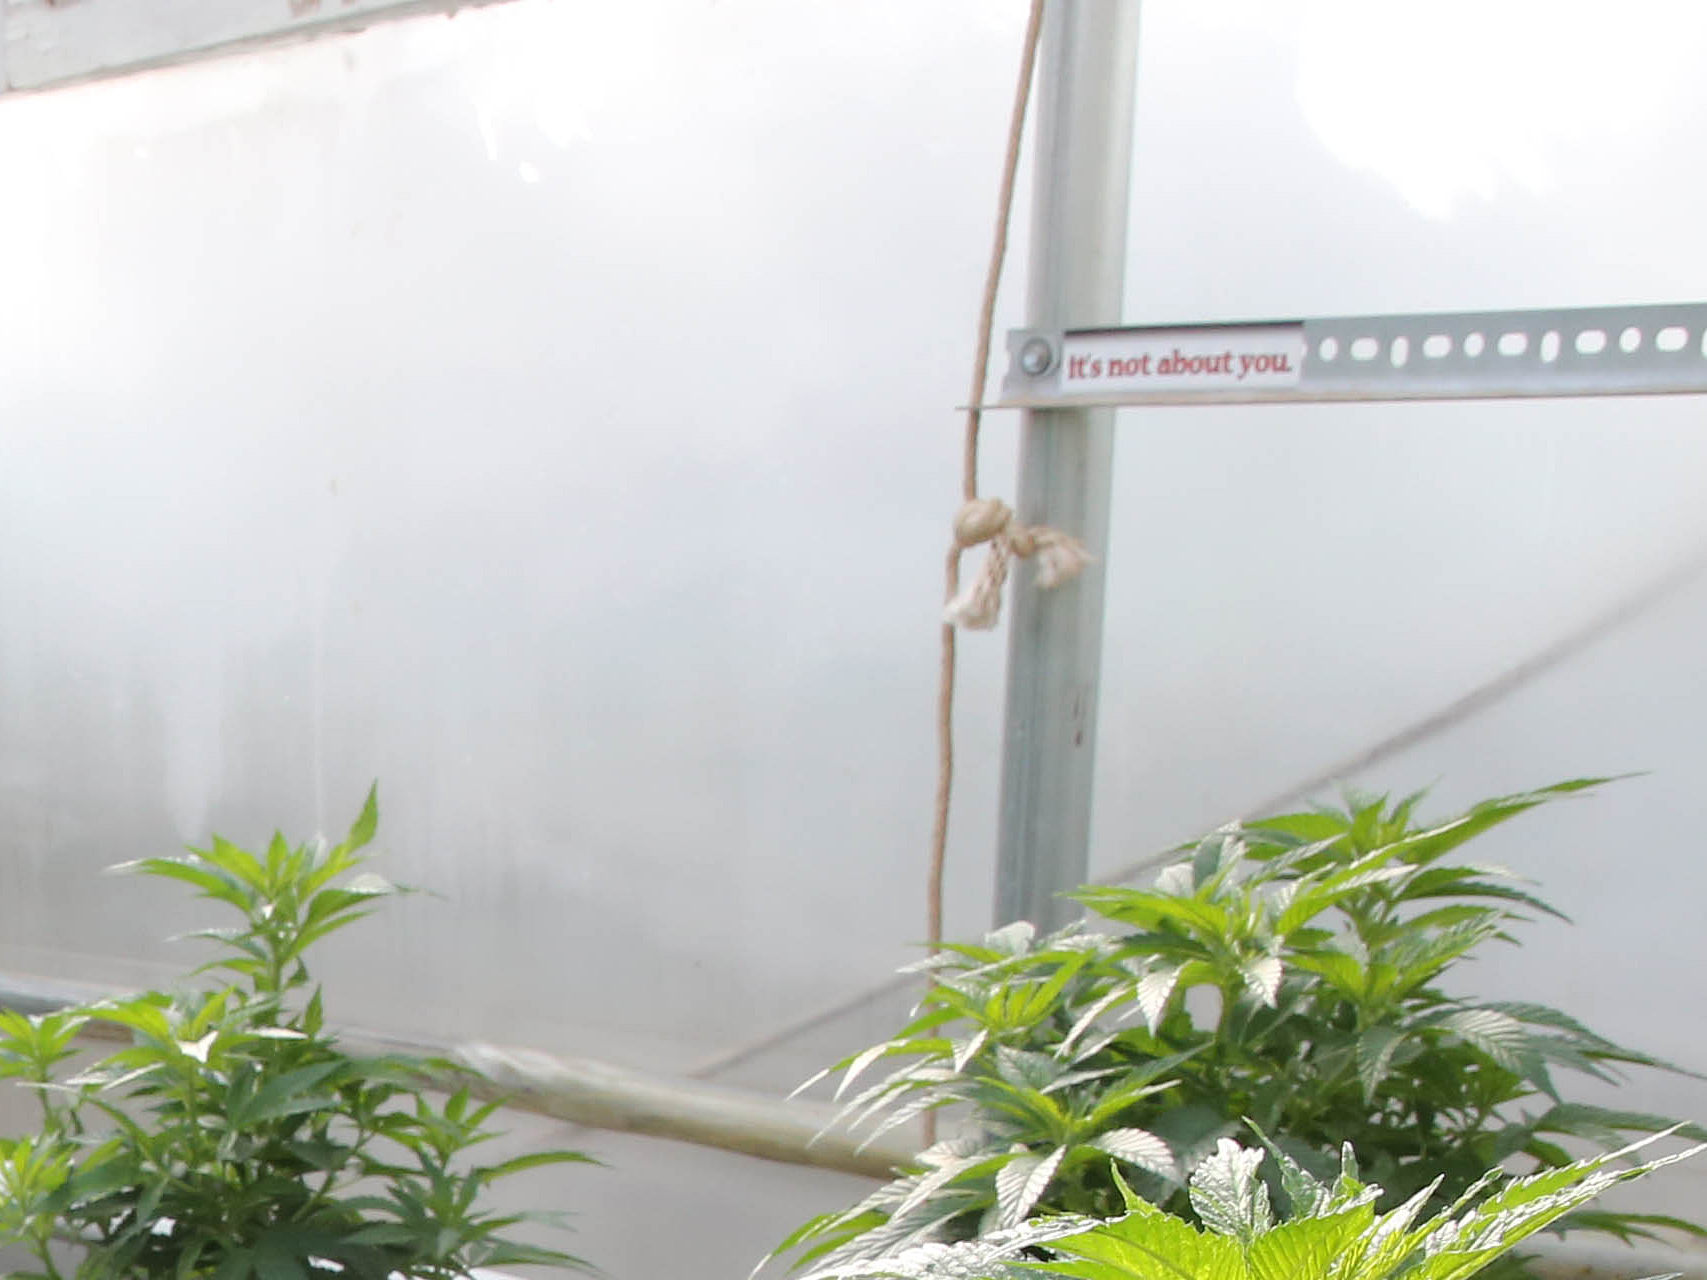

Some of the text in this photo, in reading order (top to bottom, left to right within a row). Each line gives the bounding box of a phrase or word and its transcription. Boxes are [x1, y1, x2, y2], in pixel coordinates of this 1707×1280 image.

[1068, 347, 1293, 381] It's not about you.
